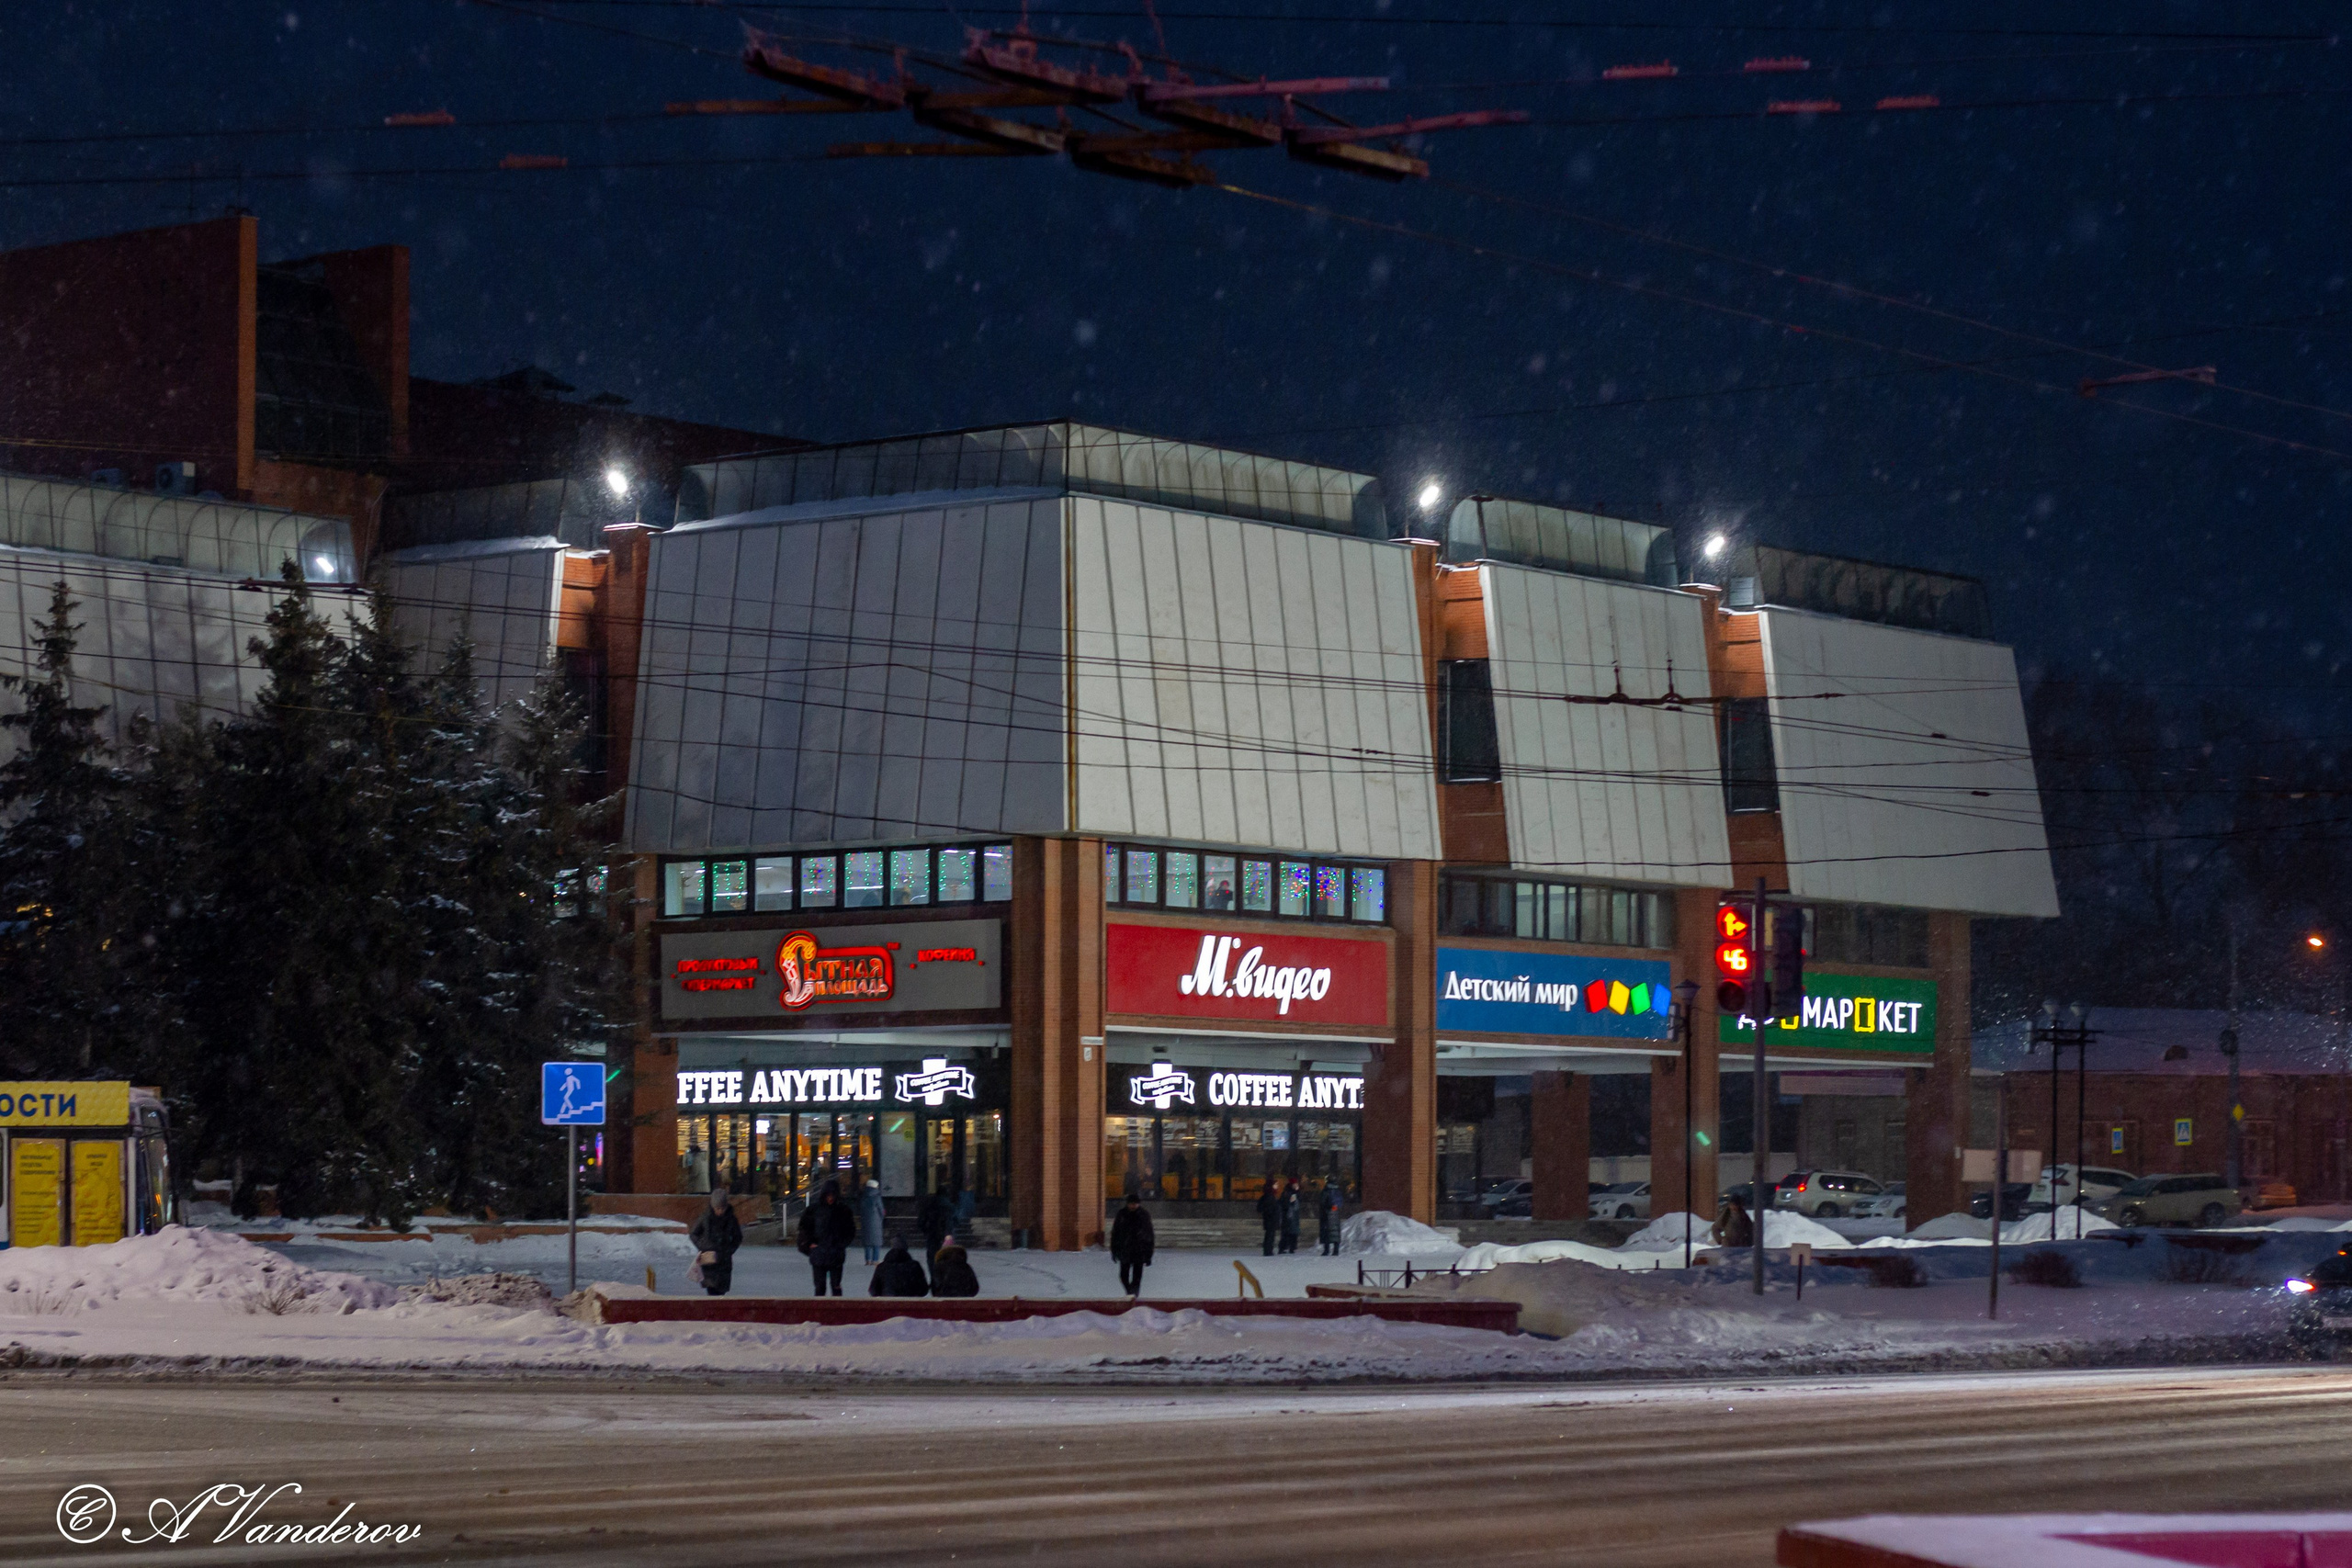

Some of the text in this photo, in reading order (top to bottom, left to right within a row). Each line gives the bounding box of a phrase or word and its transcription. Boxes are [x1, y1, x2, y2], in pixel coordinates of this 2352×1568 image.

[1445, 970, 1579, 1012] Детский мир
[676, 1071, 743, 1104] FFEE
[749, 1067, 883, 1103] ANYTIME
[1208, 1072, 1293, 1107] COFFEE
[1297, 1076, 1365, 1110] ANYT
